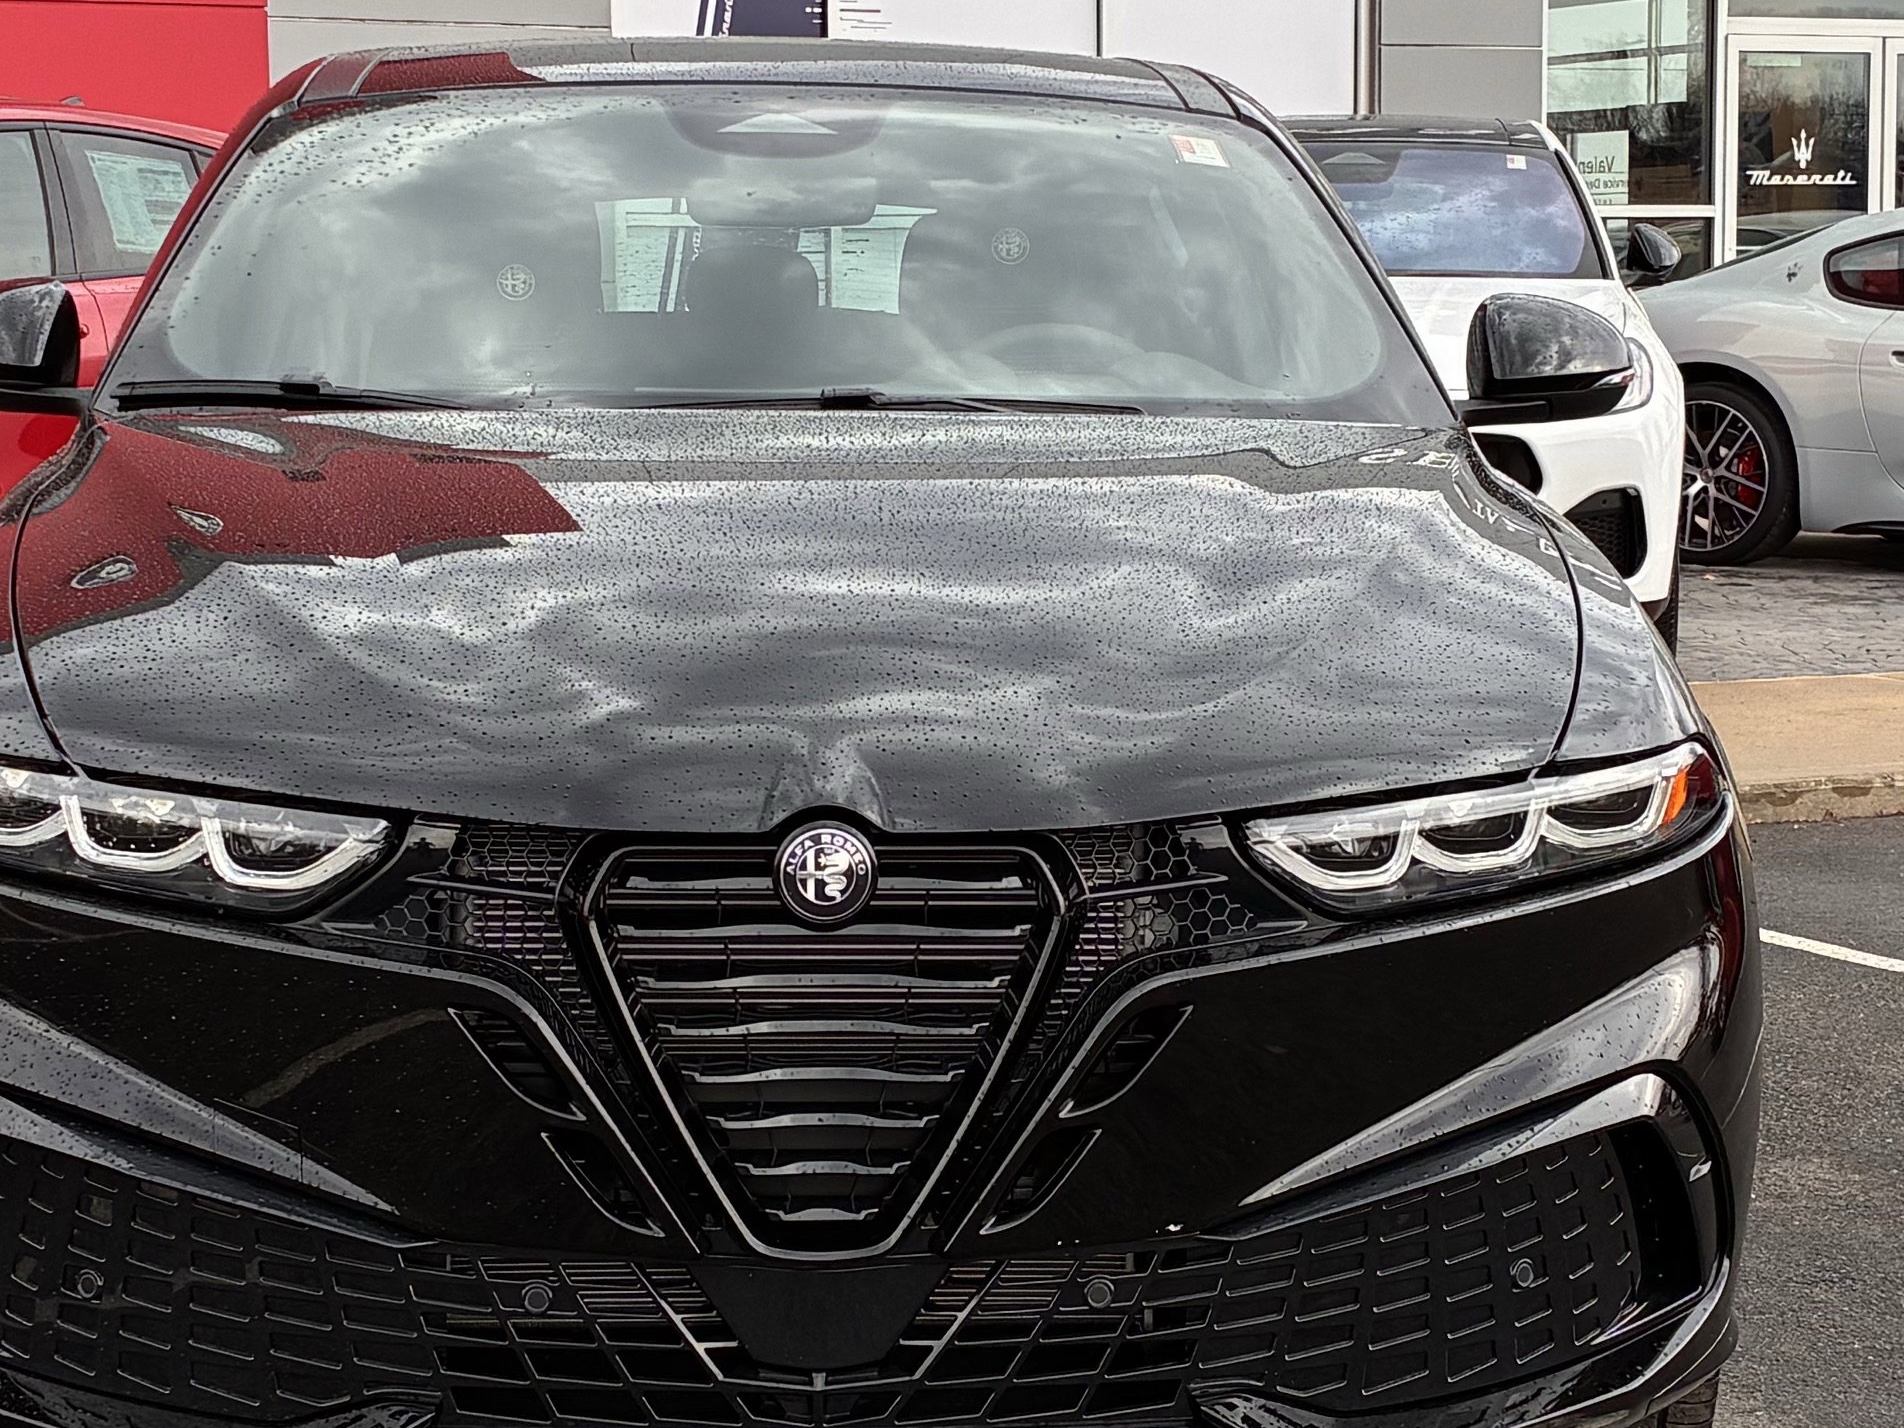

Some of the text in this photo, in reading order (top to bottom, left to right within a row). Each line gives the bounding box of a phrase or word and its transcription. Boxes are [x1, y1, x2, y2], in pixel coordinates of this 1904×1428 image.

[1746, 169, 1857, 186] Maserati
[785, 834, 868, 876] ALFA ROMEO
